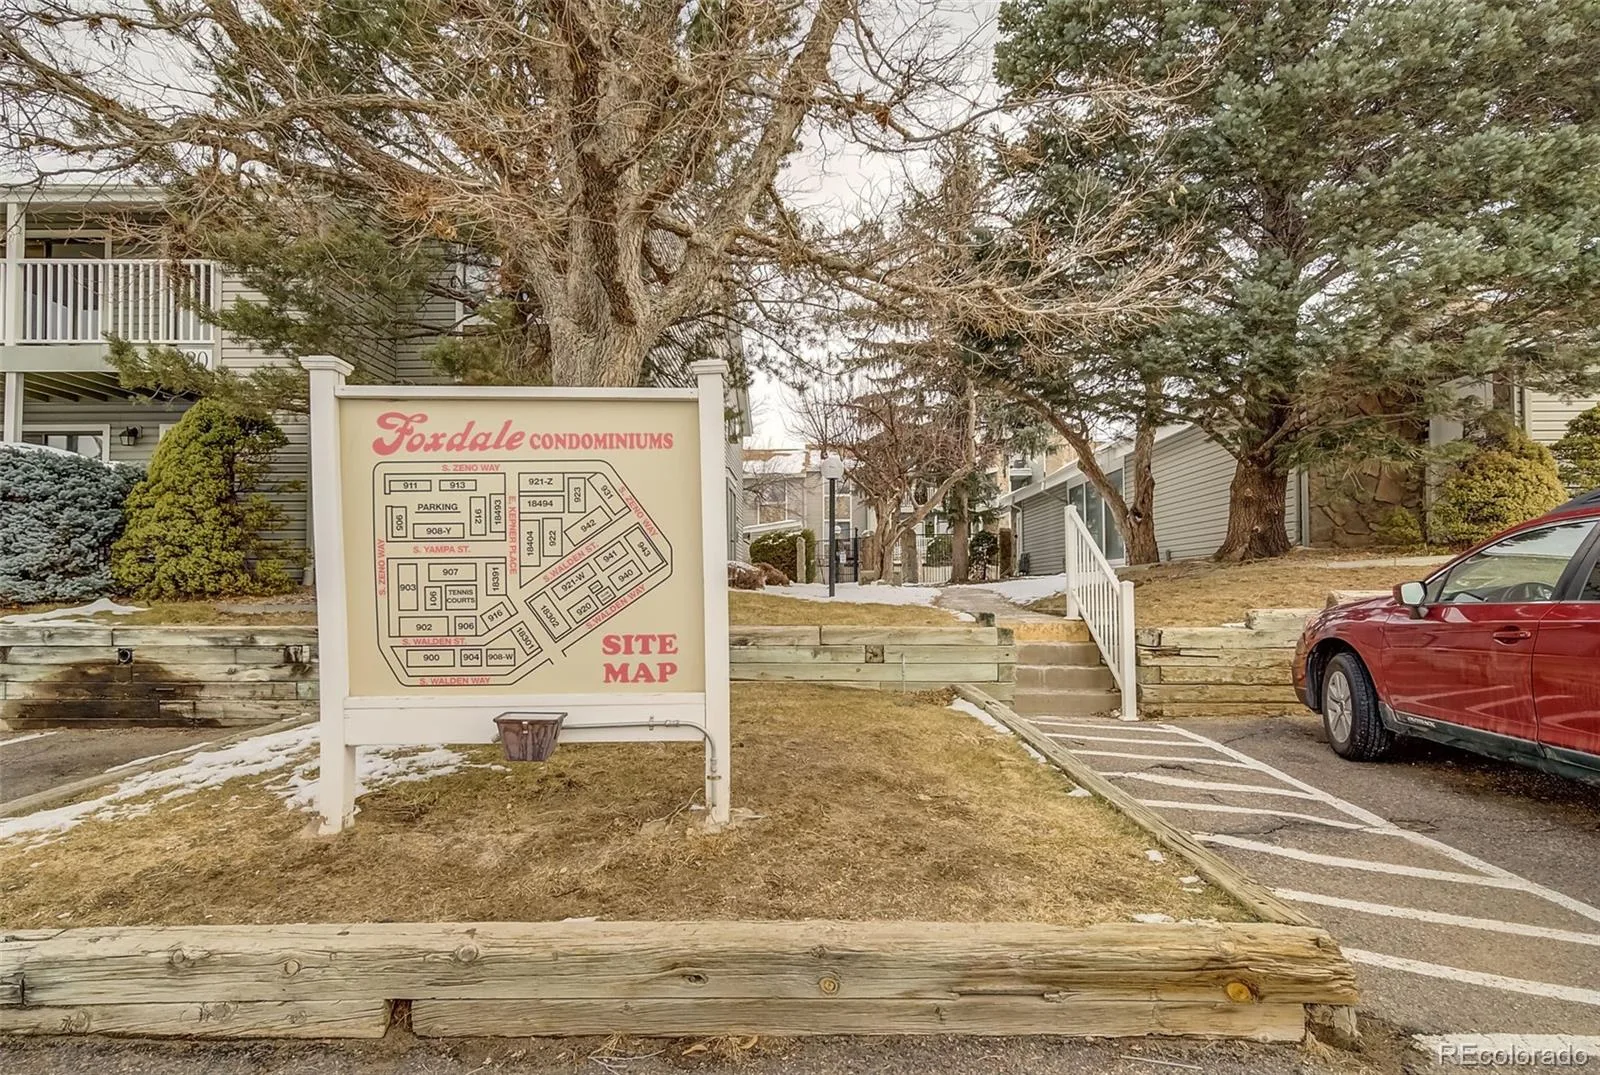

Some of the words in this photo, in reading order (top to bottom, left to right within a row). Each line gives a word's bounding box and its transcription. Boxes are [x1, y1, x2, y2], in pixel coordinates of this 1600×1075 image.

[372, 411, 526, 456] Foxdale
[529, 432, 673, 451] CONDOMINIUMS
[441, 464, 450, 472] S.
[453, 464, 478, 472] ZENO
[480, 464, 500, 472] WAY
[403, 482, 418, 490] 911
[528, 478, 553, 486] 921-Z
[573, 486, 582, 503] 923
[600, 484, 614, 500] 931
[417, 503, 459, 511] PARKING
[527, 499, 554, 507] 18494
[474, 508, 483, 525] 912
[494, 499, 502, 526] 18493
[625, 495, 644, 520] ZENO
[643, 519, 659, 538] WAY
[395, 514, 404, 532] 905
[425, 527, 452, 536] 908-Y
[508, 506, 518, 544] KEPNER
[580, 519, 597, 533] 942
[526, 530, 534, 557] 18404
[549, 529, 557, 547] 922
[377, 538, 385, 558] WAY
[413, 546, 421, 554] S.
[423, 545, 455, 554] YAMPA
[458, 545, 472, 554] ST.
[602, 550, 618, 563] 941
[637, 541, 651, 558] 943
[509, 545, 518, 576] PLACE
[378, 559, 386, 585] ZENO
[442, 568, 459, 576] 907
[492, 567, 500, 592] 18391
[617, 569, 634, 582] 940
[400, 584, 416, 592] 903
[561, 571, 586, 592] 921-W
[430, 590, 438, 607] 901
[628, 583, 647, 602] WAY
[487, 609, 504, 622] 916
[540, 604, 560, 629] 18302
[576, 602, 592, 616] 920
[457, 623, 475, 631] 906
[516, 627, 535, 650] 18301
[602, 634, 679, 656] SITE
[463, 653, 480, 661] 904
[488, 653, 514, 661] 908-W
[430, 677, 469, 685] WALDEN
[470, 677, 491, 685] WAY
[602, 662, 678, 683] MAP
